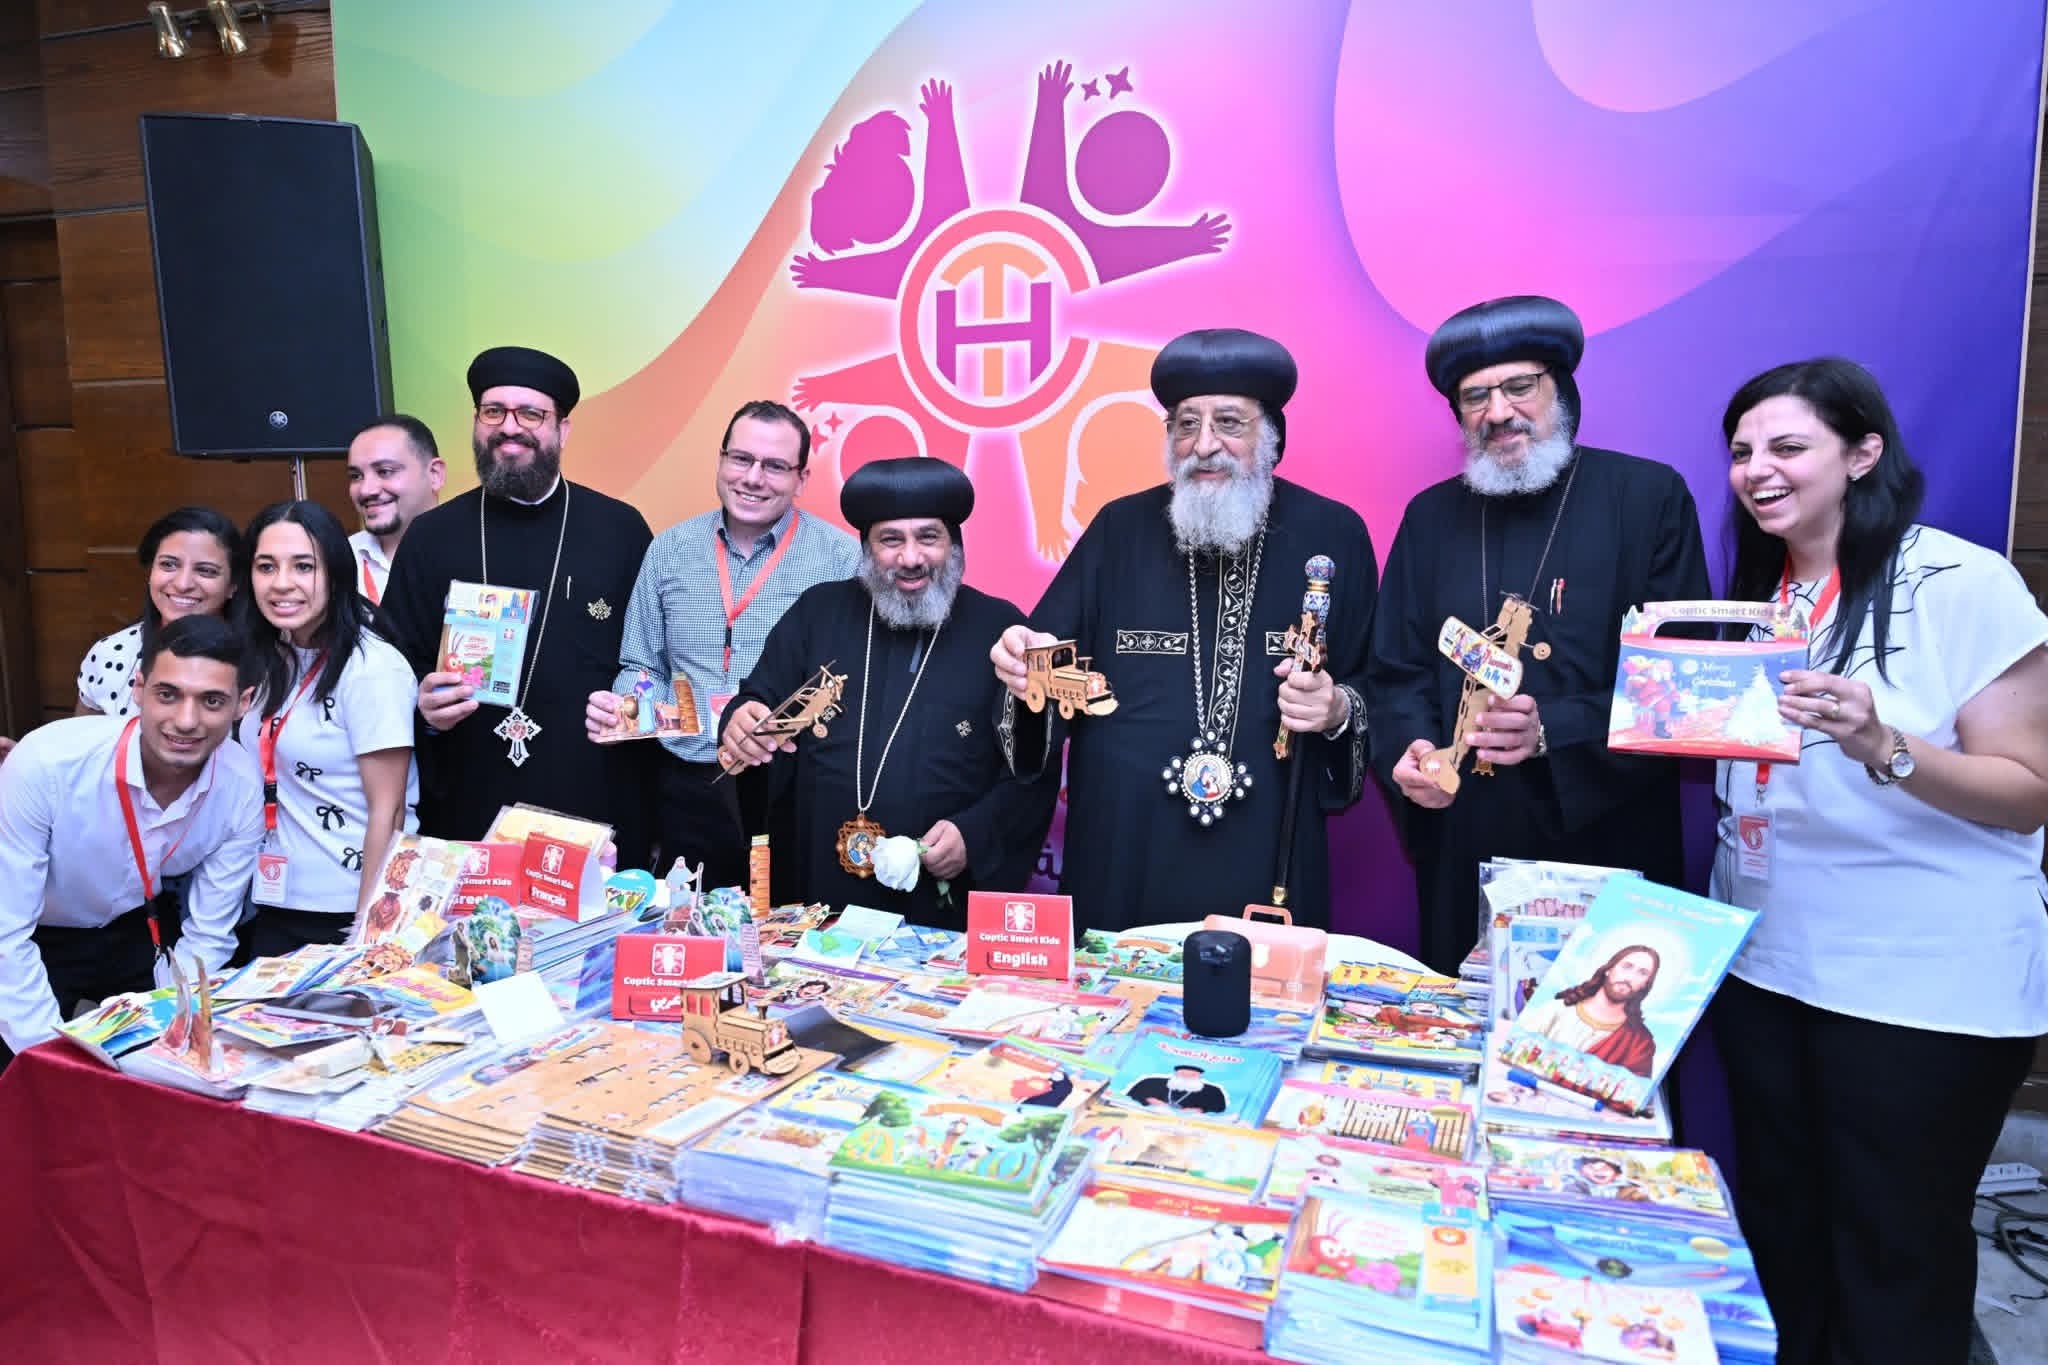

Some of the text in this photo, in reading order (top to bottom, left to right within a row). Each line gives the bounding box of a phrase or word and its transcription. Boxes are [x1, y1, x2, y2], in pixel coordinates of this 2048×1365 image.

[1672, 606, 1707, 618] Coptic
[1711, 606, 1746, 616] Smart
[463, 877, 491, 886] Smart
[492, 877, 513, 886] Kids
[531, 885, 567, 907] Français
[979, 932, 1060, 945] Coptic Smart Kids
[993, 951, 1048, 967] English
[623, 976, 655, 987] Coptic
